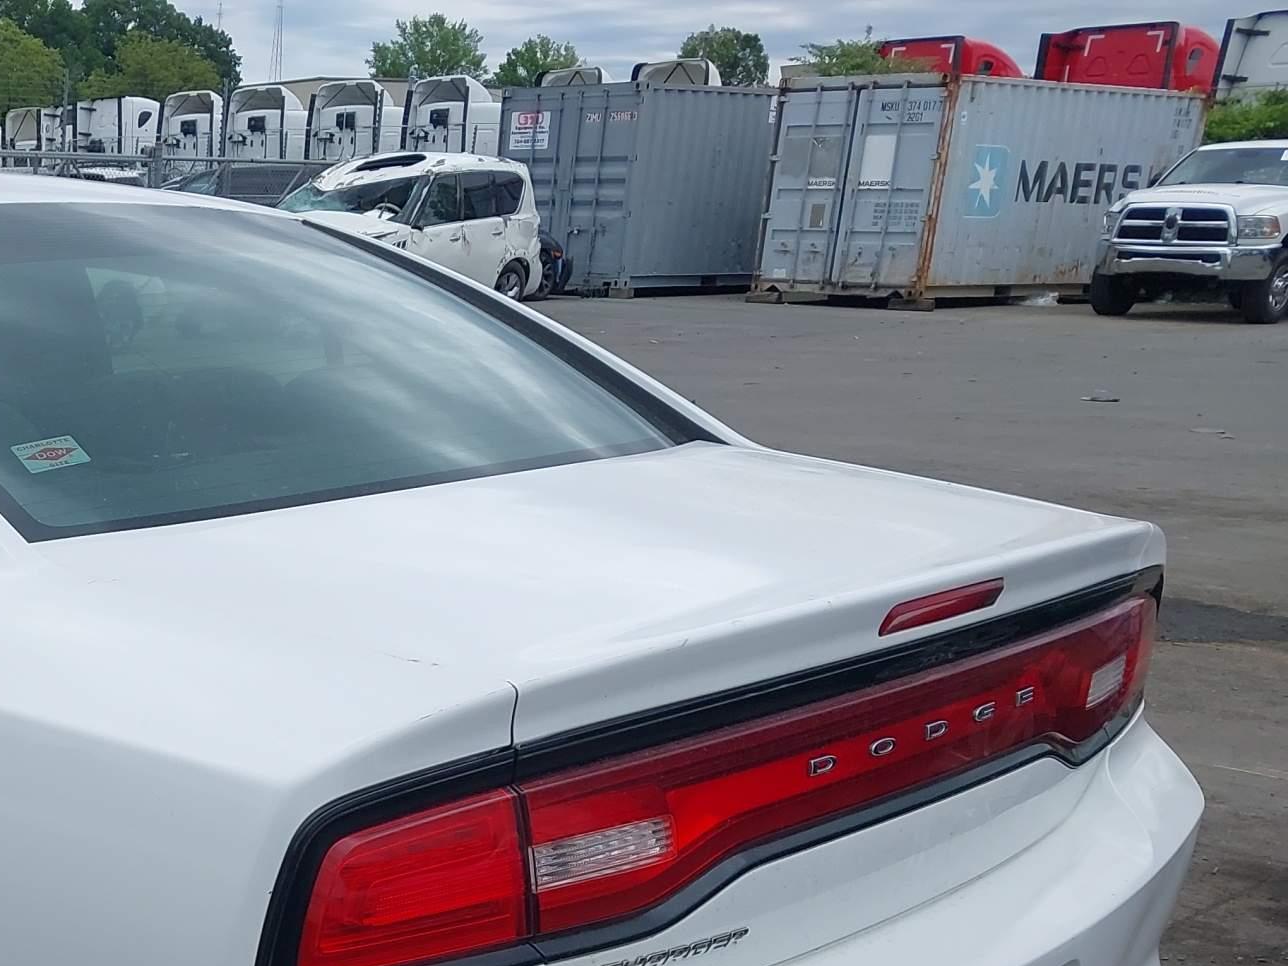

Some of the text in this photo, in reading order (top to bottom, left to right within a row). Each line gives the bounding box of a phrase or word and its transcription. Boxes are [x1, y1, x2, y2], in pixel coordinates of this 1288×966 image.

[880, 101, 900, 111] MSKU
[16, 438, 70, 452] CHARLOTTE
[808, 686, 1035, 777] DODGE
